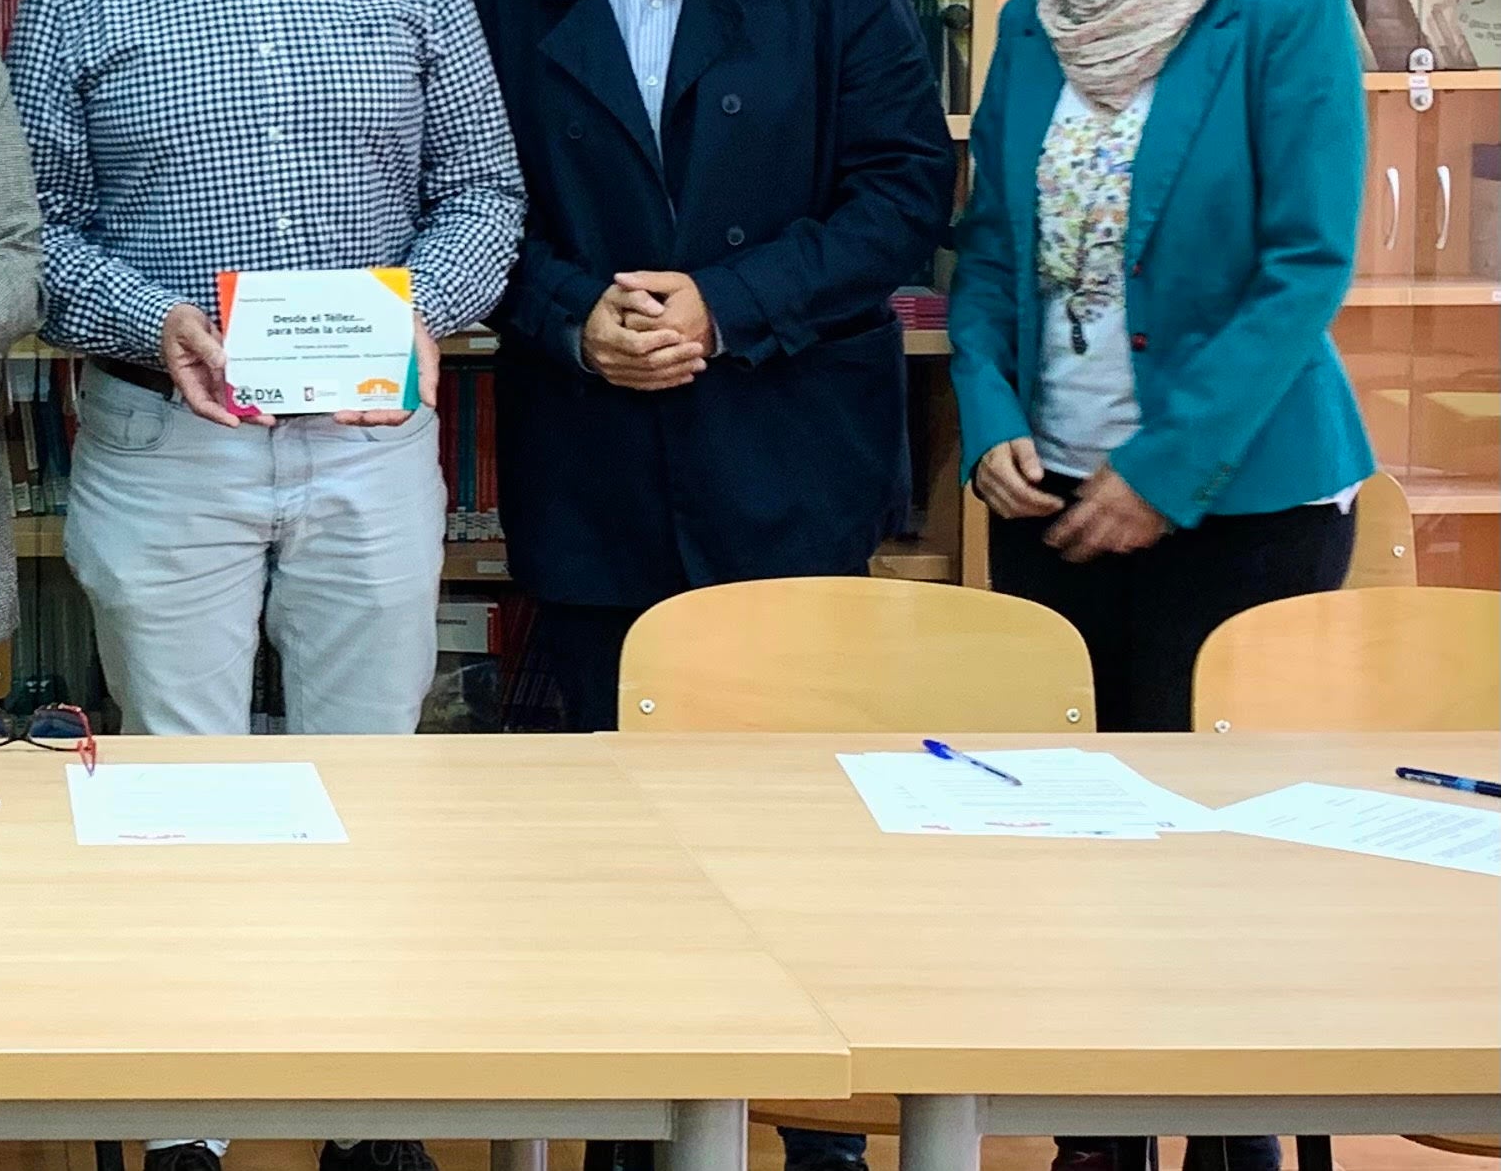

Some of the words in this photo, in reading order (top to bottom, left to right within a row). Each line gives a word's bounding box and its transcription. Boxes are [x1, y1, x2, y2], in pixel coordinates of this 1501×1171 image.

[273, 314, 307, 323] Desde
[311, 313, 321, 323] el
[266, 325, 292, 337] para
[295, 325, 320, 335] toda
[323, 324, 334, 334] la
[336, 324, 373, 334] ciudad
[255, 388, 283, 401] DYA
